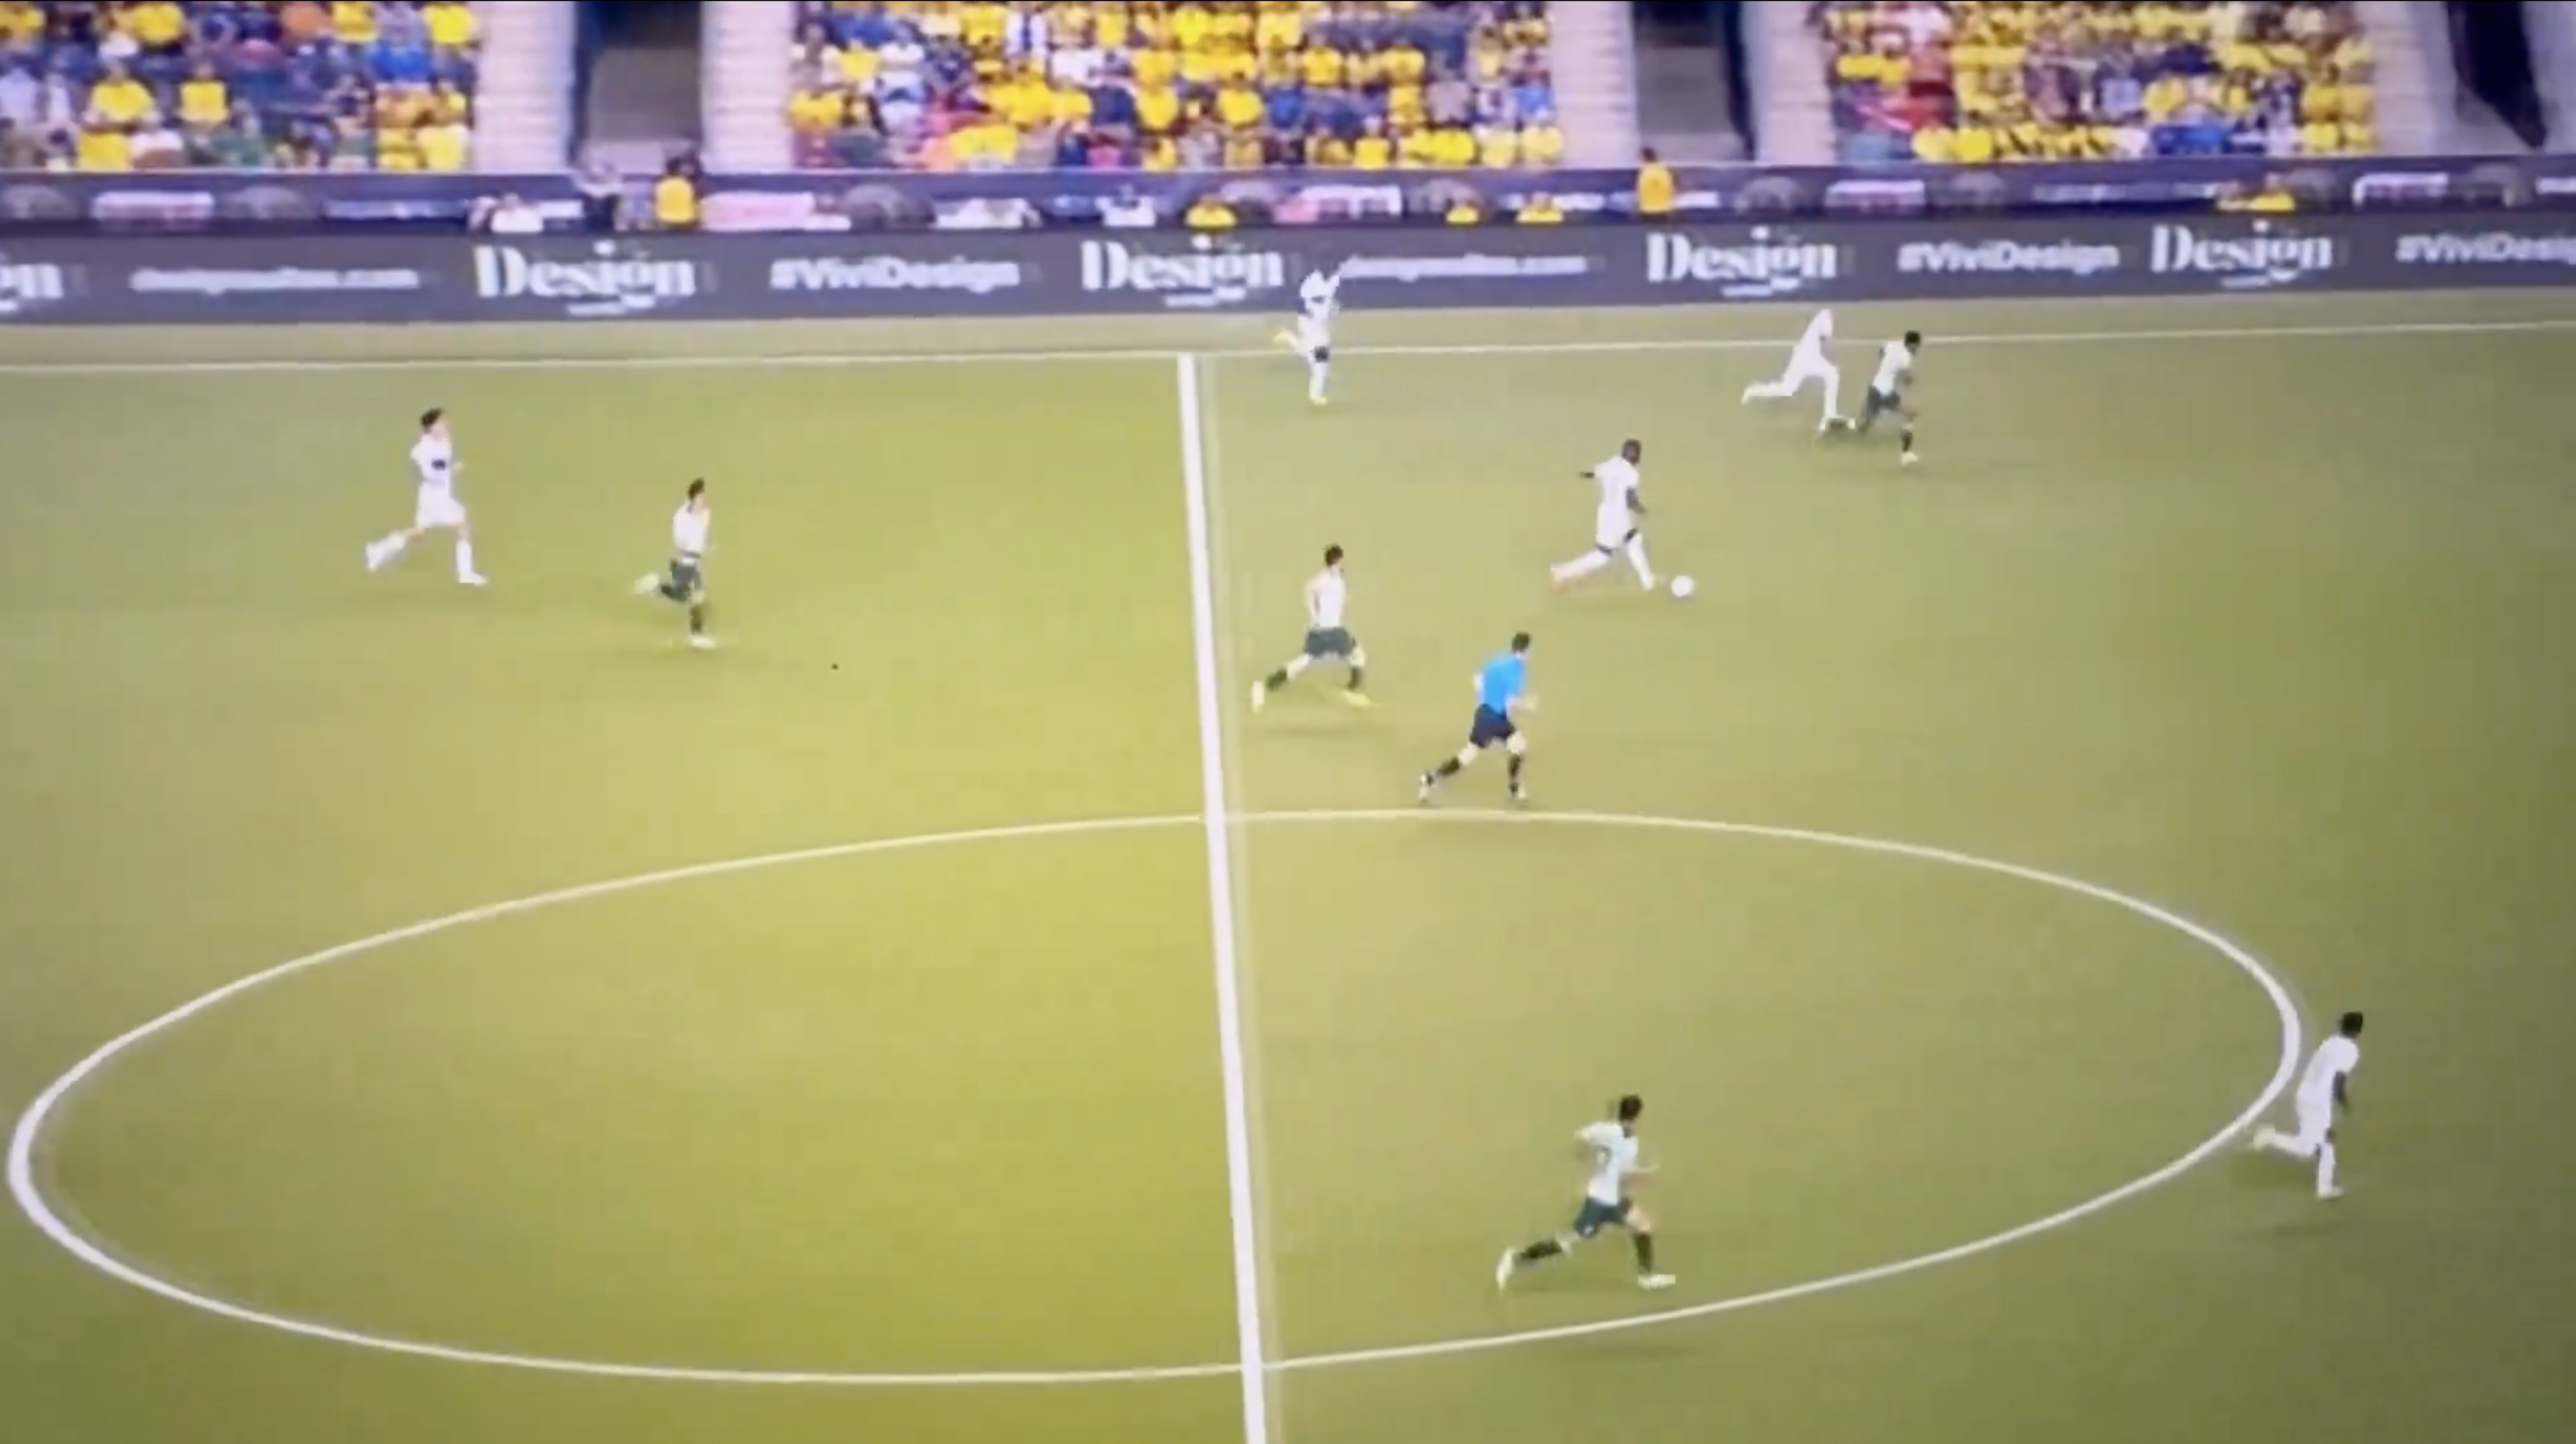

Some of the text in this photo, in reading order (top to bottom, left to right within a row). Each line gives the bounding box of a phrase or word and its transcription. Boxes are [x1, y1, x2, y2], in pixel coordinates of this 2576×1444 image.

[473, 239, 695, 316] Design
[1080, 233, 1284, 307] Design
[1647, 225, 1836, 296] Design
[2151, 217, 2333, 288] Design
